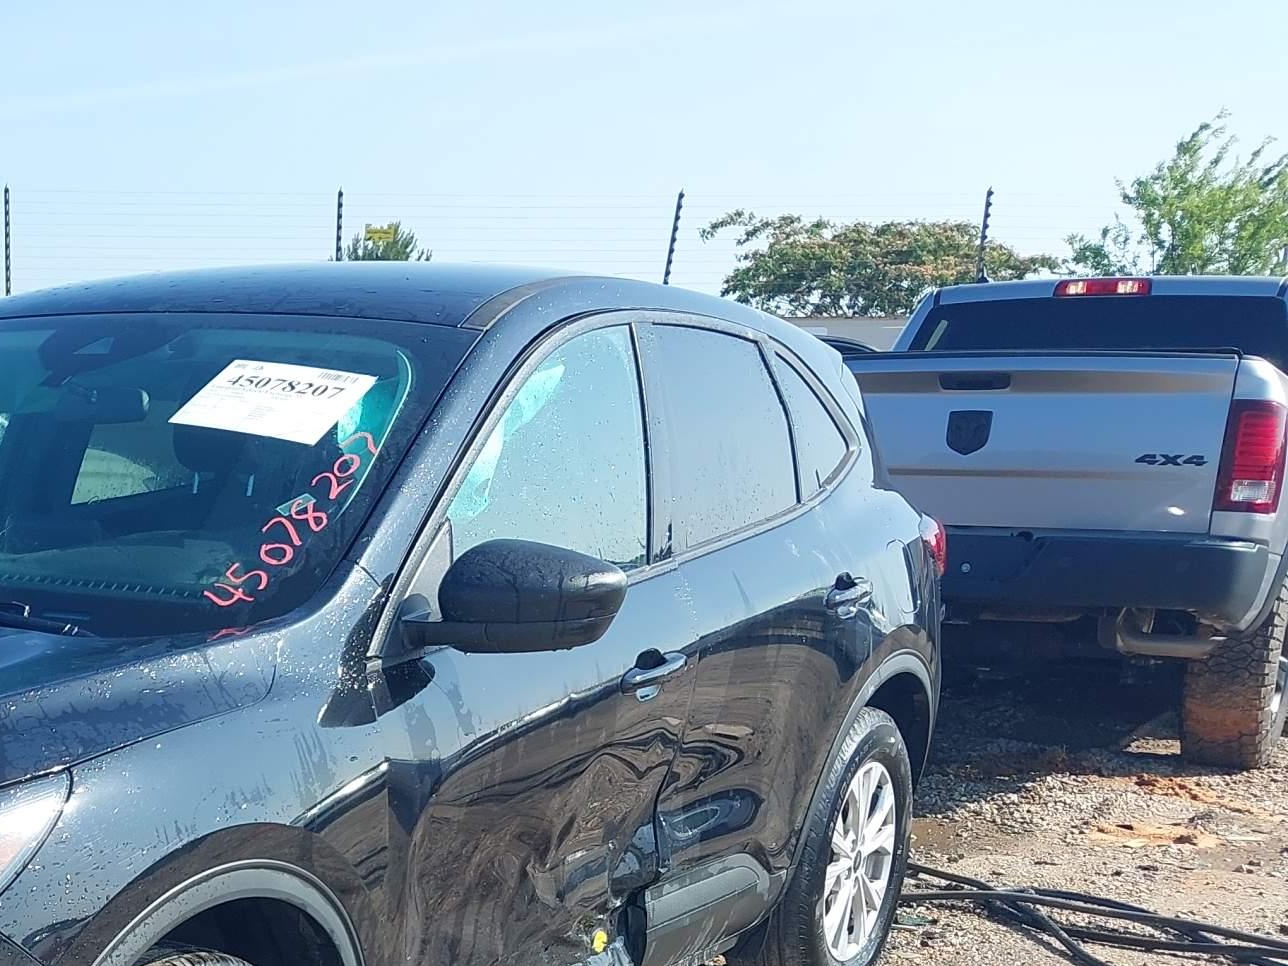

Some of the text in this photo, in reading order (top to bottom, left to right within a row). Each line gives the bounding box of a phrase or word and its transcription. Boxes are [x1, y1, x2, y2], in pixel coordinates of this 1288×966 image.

[227, 374, 346, 399] 45078207
[1134, 453, 1209, 467] 4X4
[203, 430, 378, 607] 45078207
